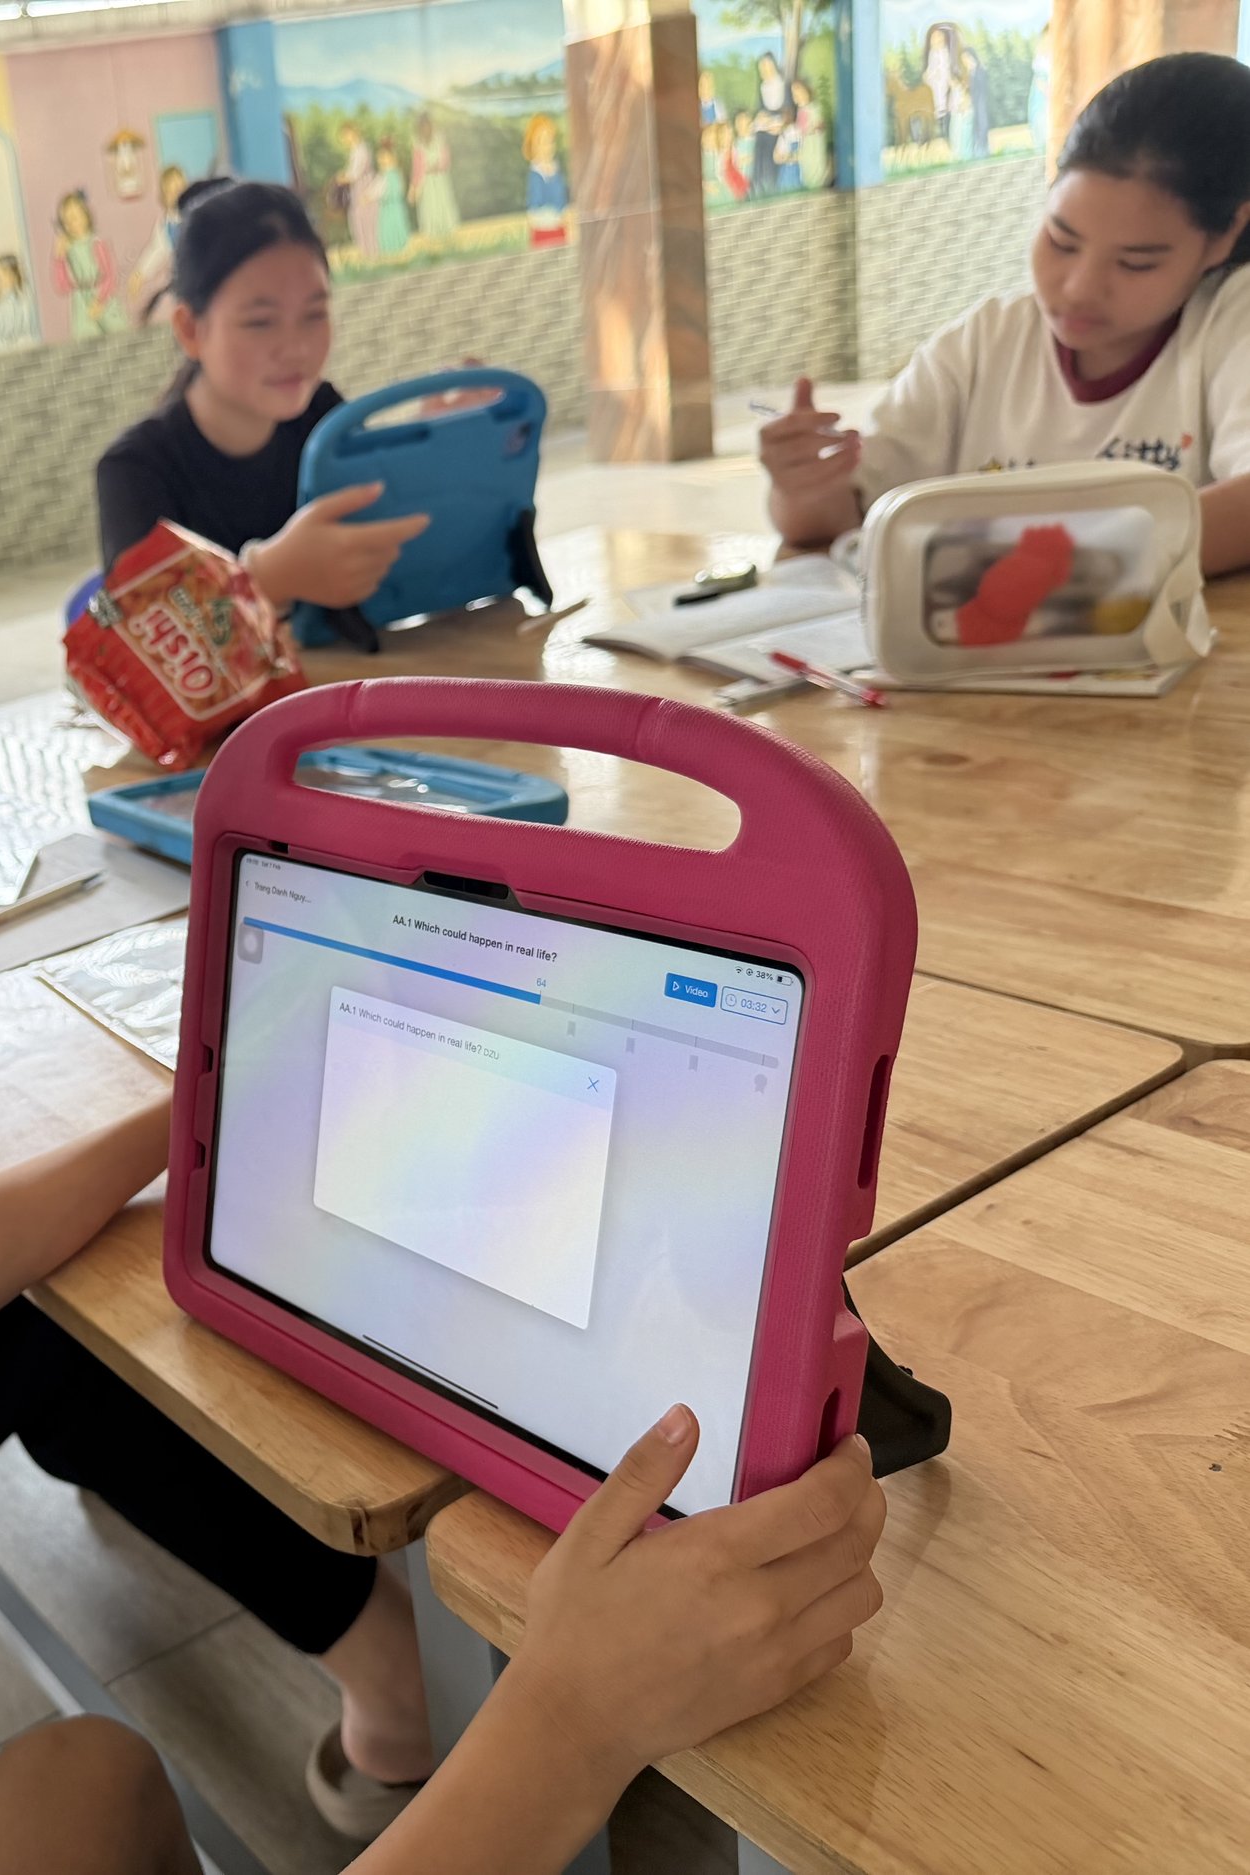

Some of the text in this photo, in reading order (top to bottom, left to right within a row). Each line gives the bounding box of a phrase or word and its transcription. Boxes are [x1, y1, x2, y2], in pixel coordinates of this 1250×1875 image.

[134, 609, 214, 693] Oishi
[254, 882, 271, 895] Trang
[271, 886, 288, 897] Danh
[392, 914, 557, 962] AA.1 Which could happen in real life?
[536, 978, 547, 988] 64
[755, 970, 774, 981] 38%
[685, 984, 709, 998] Video
[740, 998, 767, 1013] 03:32
[339, 1002, 500, 1060] AA.1 Which could happen in real life? DZU
